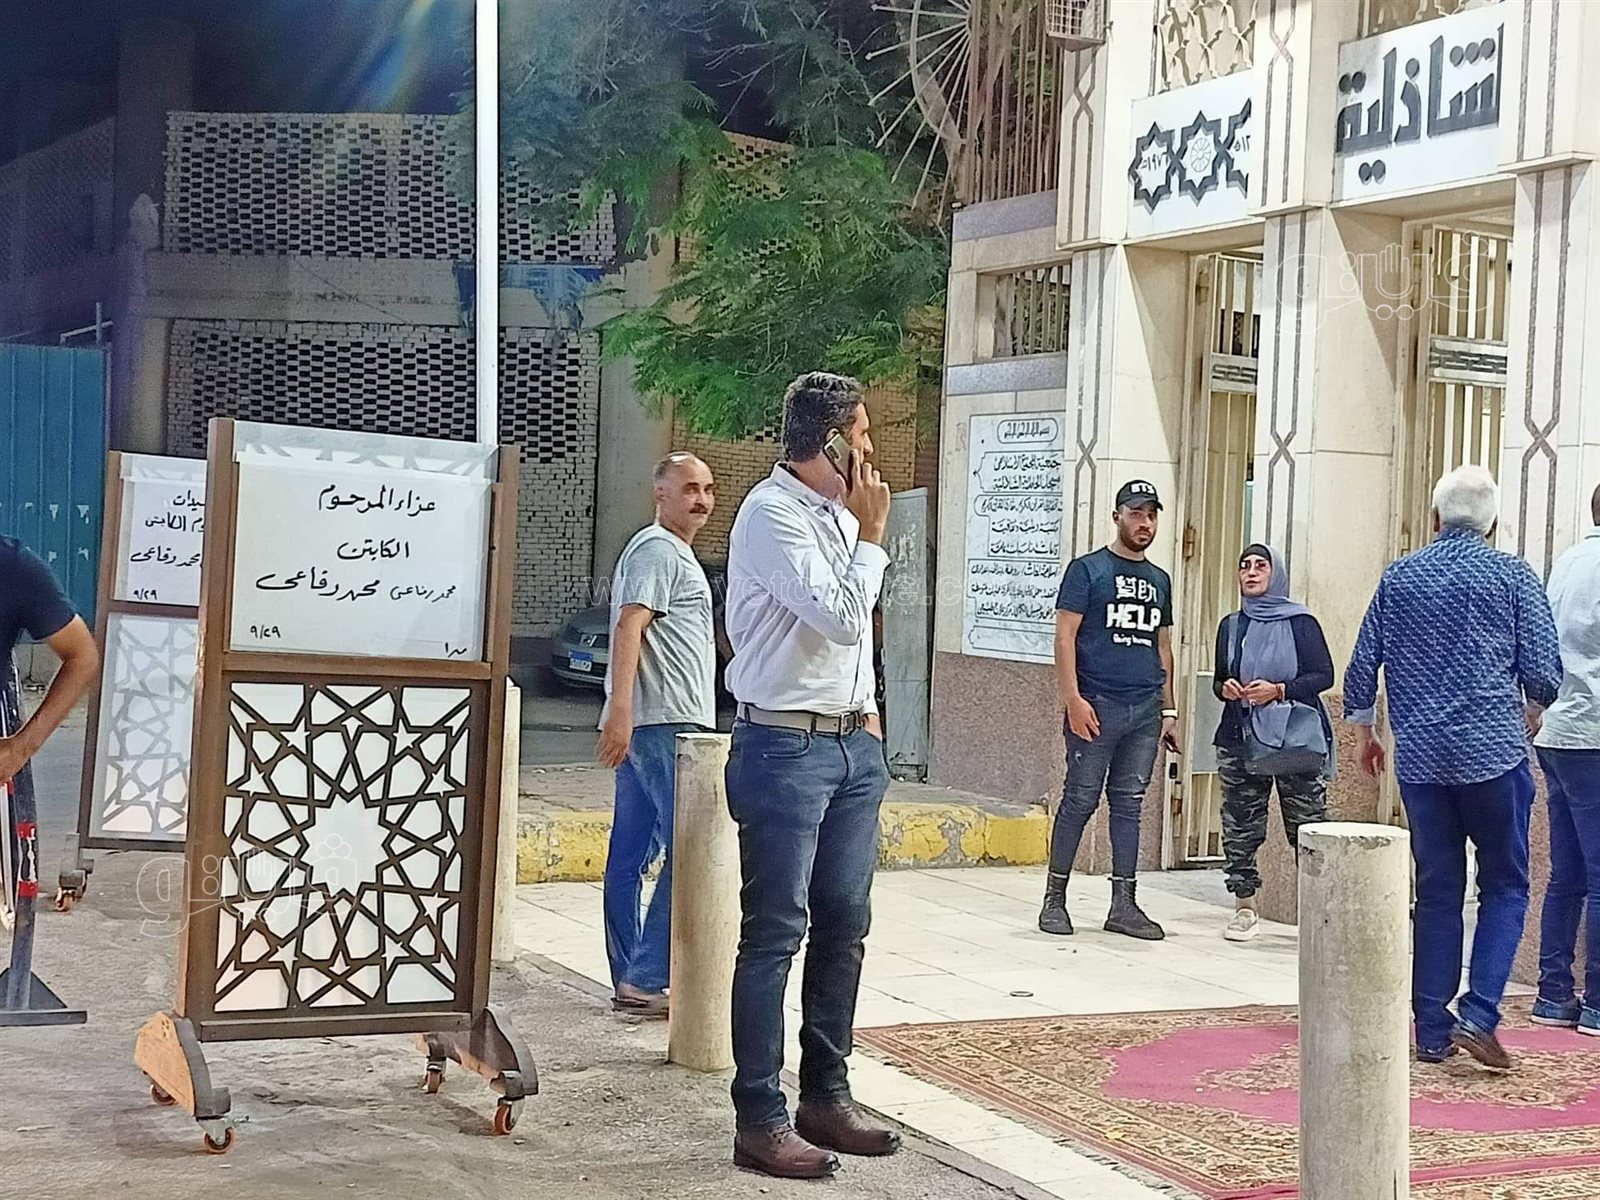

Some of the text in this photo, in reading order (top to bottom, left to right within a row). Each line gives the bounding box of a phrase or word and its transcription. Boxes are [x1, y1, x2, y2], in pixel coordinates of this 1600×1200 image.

[318, 484, 394, 513] المرحوم
[336, 538, 409, 561] الكابتن
[1105, 603, 1162, 632] HELP
